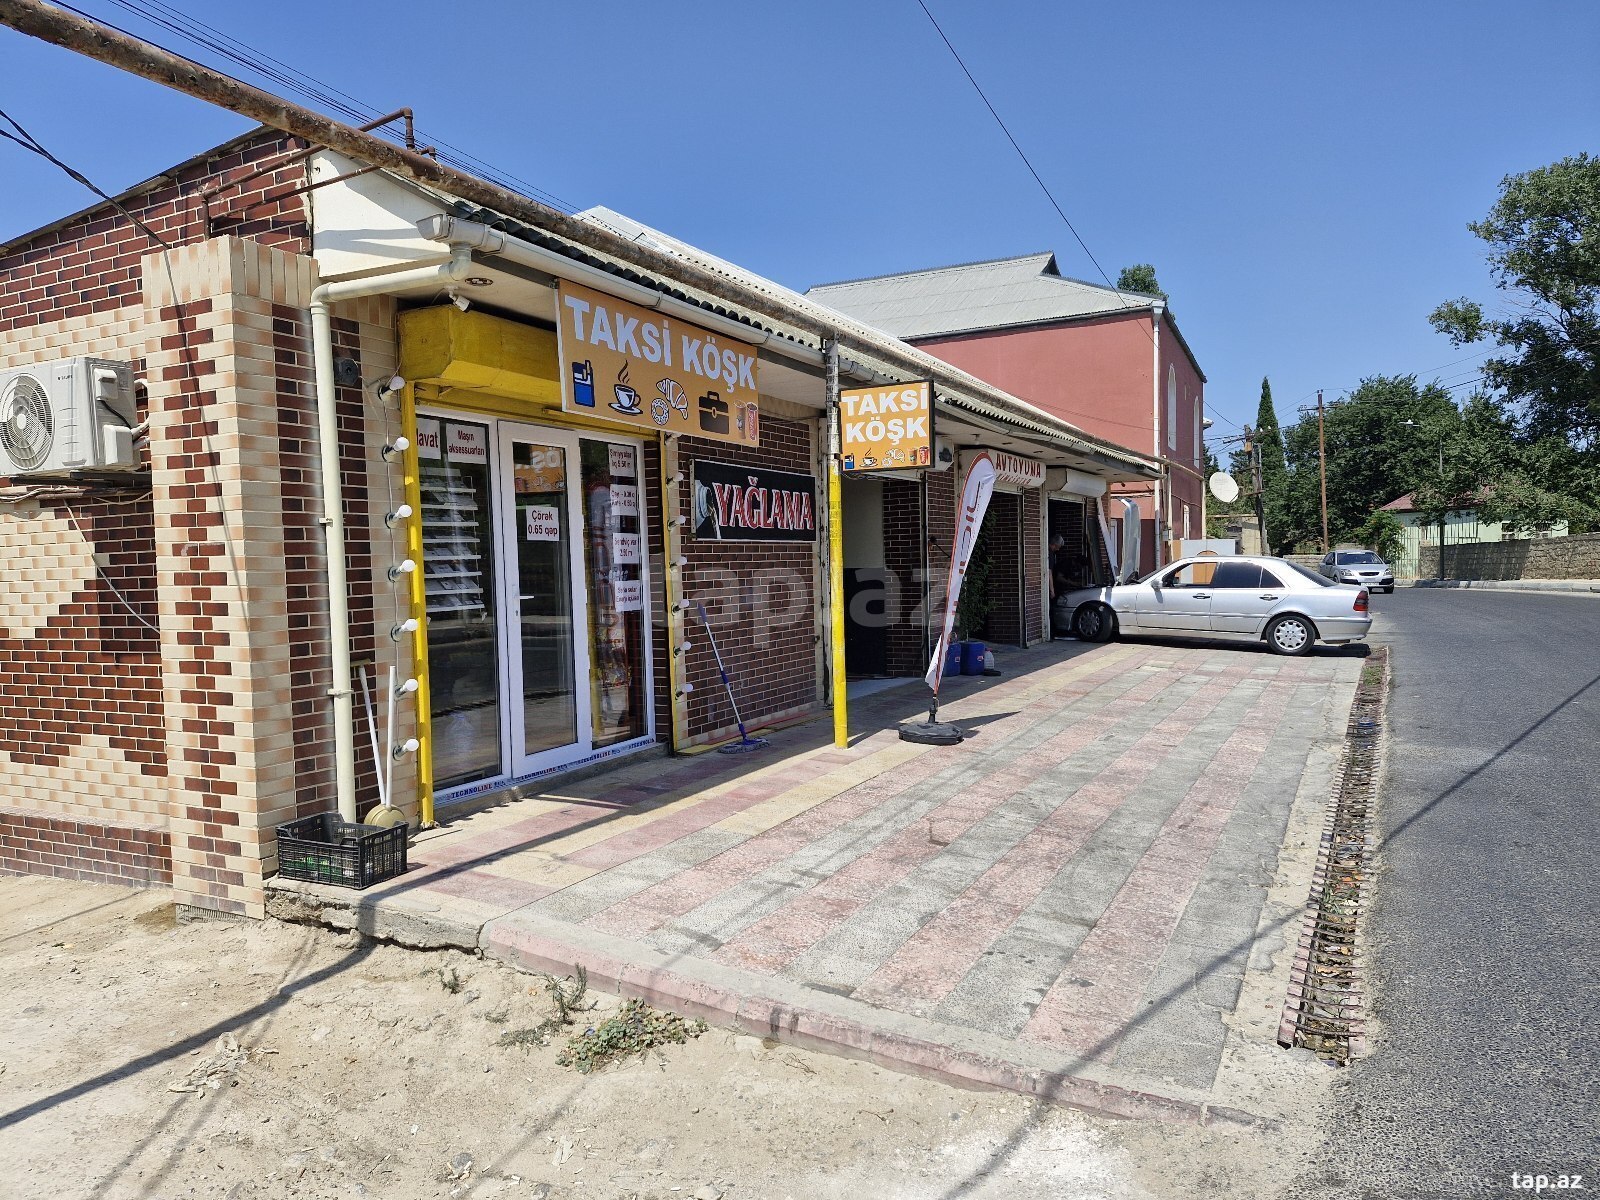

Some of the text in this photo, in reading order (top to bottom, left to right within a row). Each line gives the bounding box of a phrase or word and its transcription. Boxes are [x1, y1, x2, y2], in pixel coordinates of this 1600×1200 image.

[565, 295, 756, 393] TAKSİ KÖŞK
[841, 384, 929, 417] TAKSİ
[846, 417, 928, 445] KÖŞK
[995, 453, 1041, 479] AVTOYUNA
[712, 476, 815, 530] YAĞLAMA
[528, 524, 543, 535] 0.65
